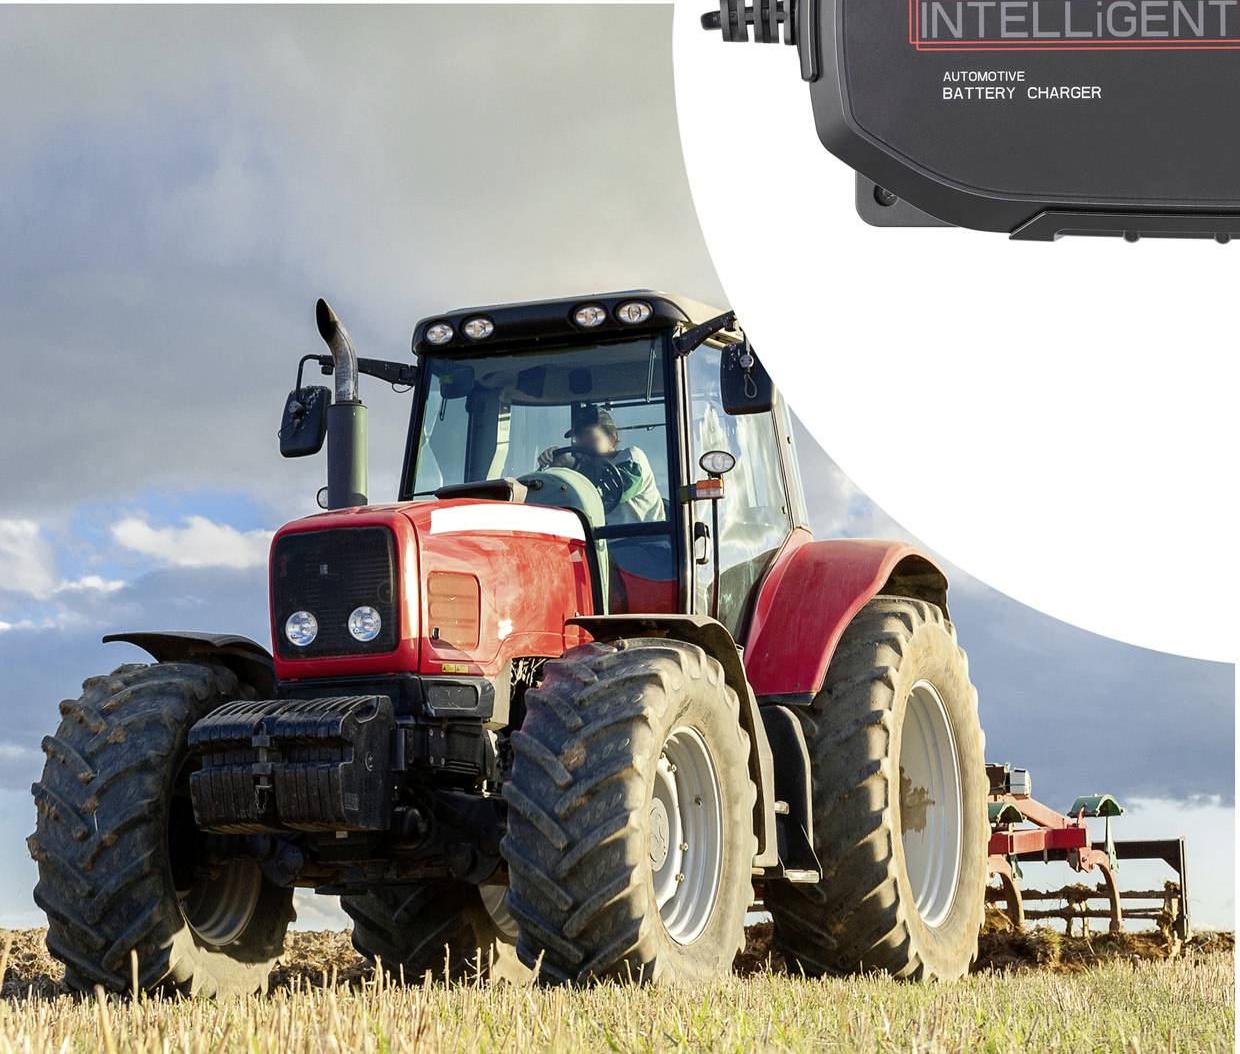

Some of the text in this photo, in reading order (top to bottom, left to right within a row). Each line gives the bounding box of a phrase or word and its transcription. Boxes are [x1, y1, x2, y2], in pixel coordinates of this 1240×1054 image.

[920, 0, 1238, 39] INTELLiGENT
[942, 70, 1026, 82] AUTOMOTIVE
[942, 85, 1102, 100] BATTERY CHARGER
